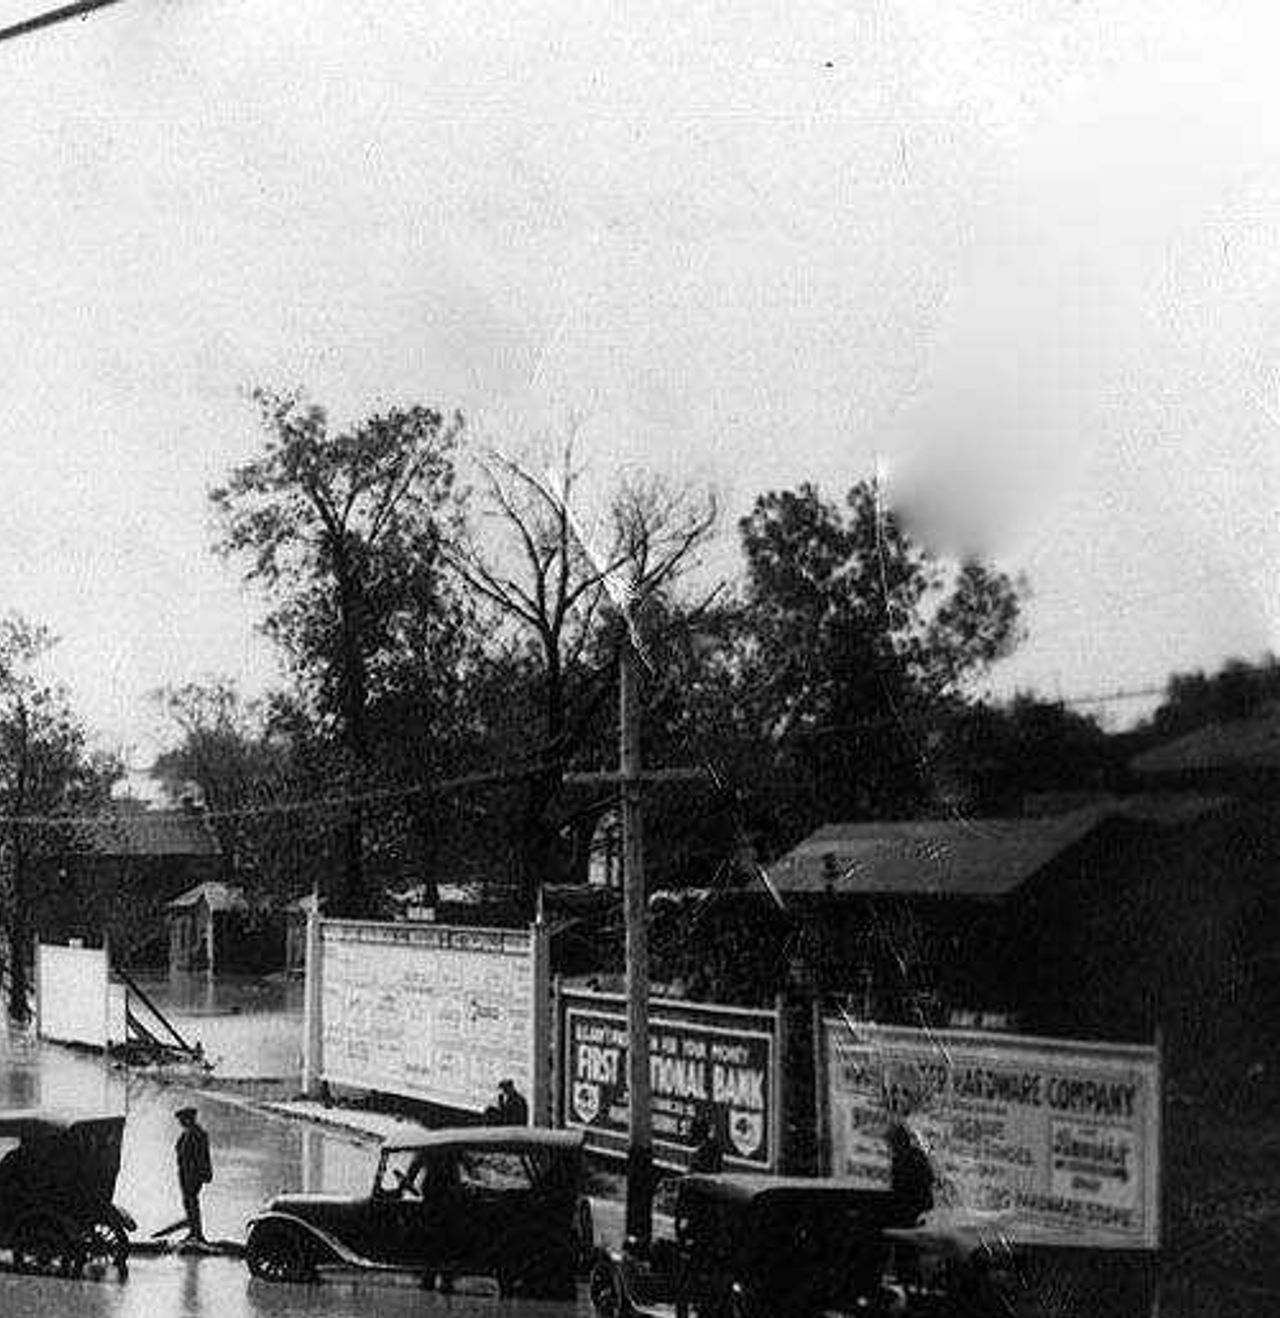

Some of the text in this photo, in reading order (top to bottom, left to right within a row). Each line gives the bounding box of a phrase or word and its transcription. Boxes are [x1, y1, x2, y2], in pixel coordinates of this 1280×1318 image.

[577, 1044, 620, 1087] FIRST
[627, 1054, 708, 1100] TIONAL
[713, 1063, 765, 1110] BANK
[682, 1040, 707, 1058] YOUR
[711, 1044, 749, 1065] MONEY
[952, 1066, 1042, 1108] HARDWARE
[1046, 1075, 1138, 1118] COMPANY
